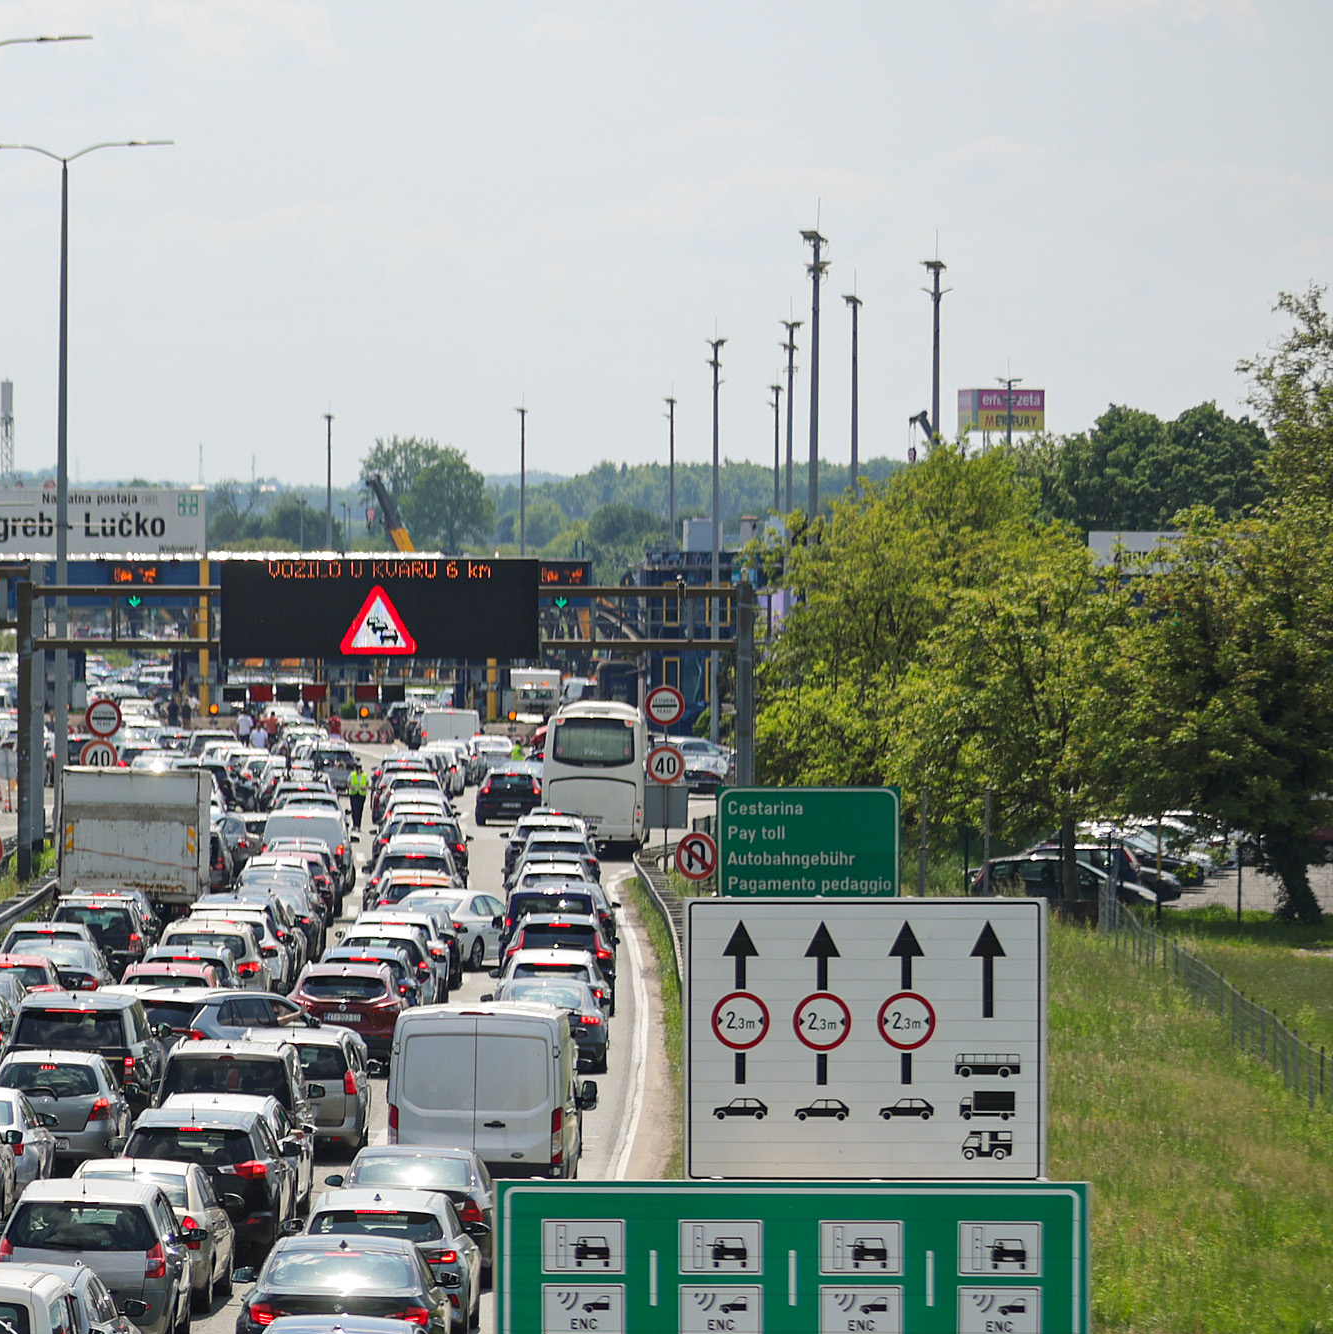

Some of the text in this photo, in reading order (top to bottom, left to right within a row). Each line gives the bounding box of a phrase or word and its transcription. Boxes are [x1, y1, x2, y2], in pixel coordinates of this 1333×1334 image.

[97, 493, 138, 506] postaja
[84, 508, 166, 538] Lučko
[350, 561, 363, 579] U
[373, 561, 437, 579] KVARU
[446, 564, 459, 579] 6
[468, 564, 492, 579] km
[89, 750, 110, 767] 40
[655, 757, 676, 774] 40
[727, 801, 804, 816] Cestarina
[727, 826, 786, 843] Pay toll
[727, 851, 856, 868] Autobahngebühr
[727, 877, 892, 894] Pagamento pedaggio
[570, 1318, 598, 1331] ENC
[707, 1318, 735, 1331] ENC
[847, 1318, 875, 1332] ENC
[985, 1319, 1013, 1333] ENC
